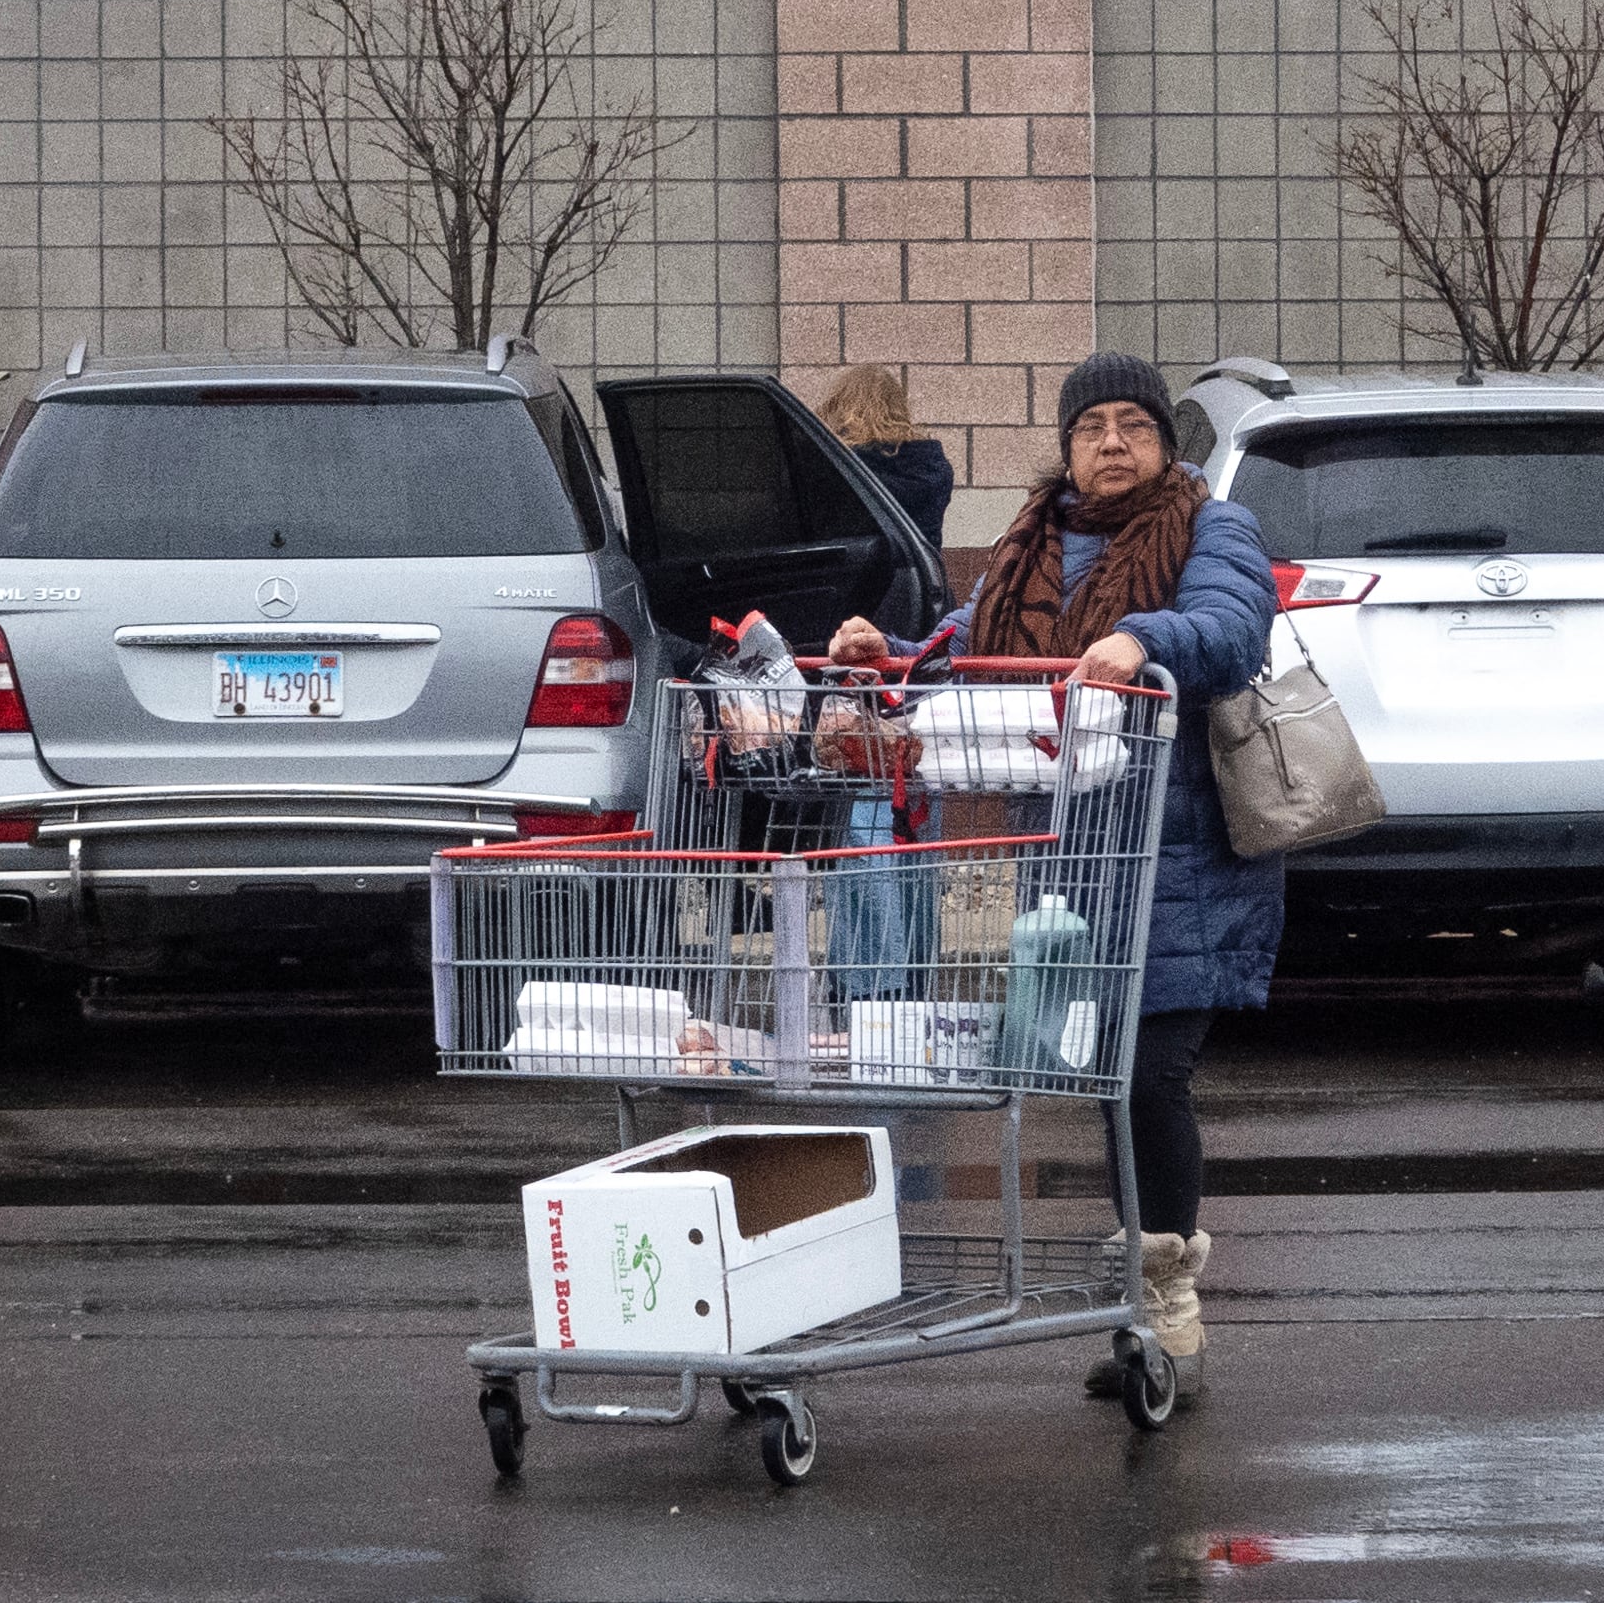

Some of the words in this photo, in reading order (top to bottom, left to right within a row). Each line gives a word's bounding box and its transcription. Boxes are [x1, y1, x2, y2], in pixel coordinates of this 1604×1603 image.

[33, 587, 81, 602] 350
[220, 672, 247, 703] BH
[263, 672, 335, 702] 43901
[547, 1199, 568, 1273] Fruit
[614, 1222, 633, 1280] Fresh
[554, 1278, 576, 1350] Bowl
[620, 1286, 637, 1325] Pak
